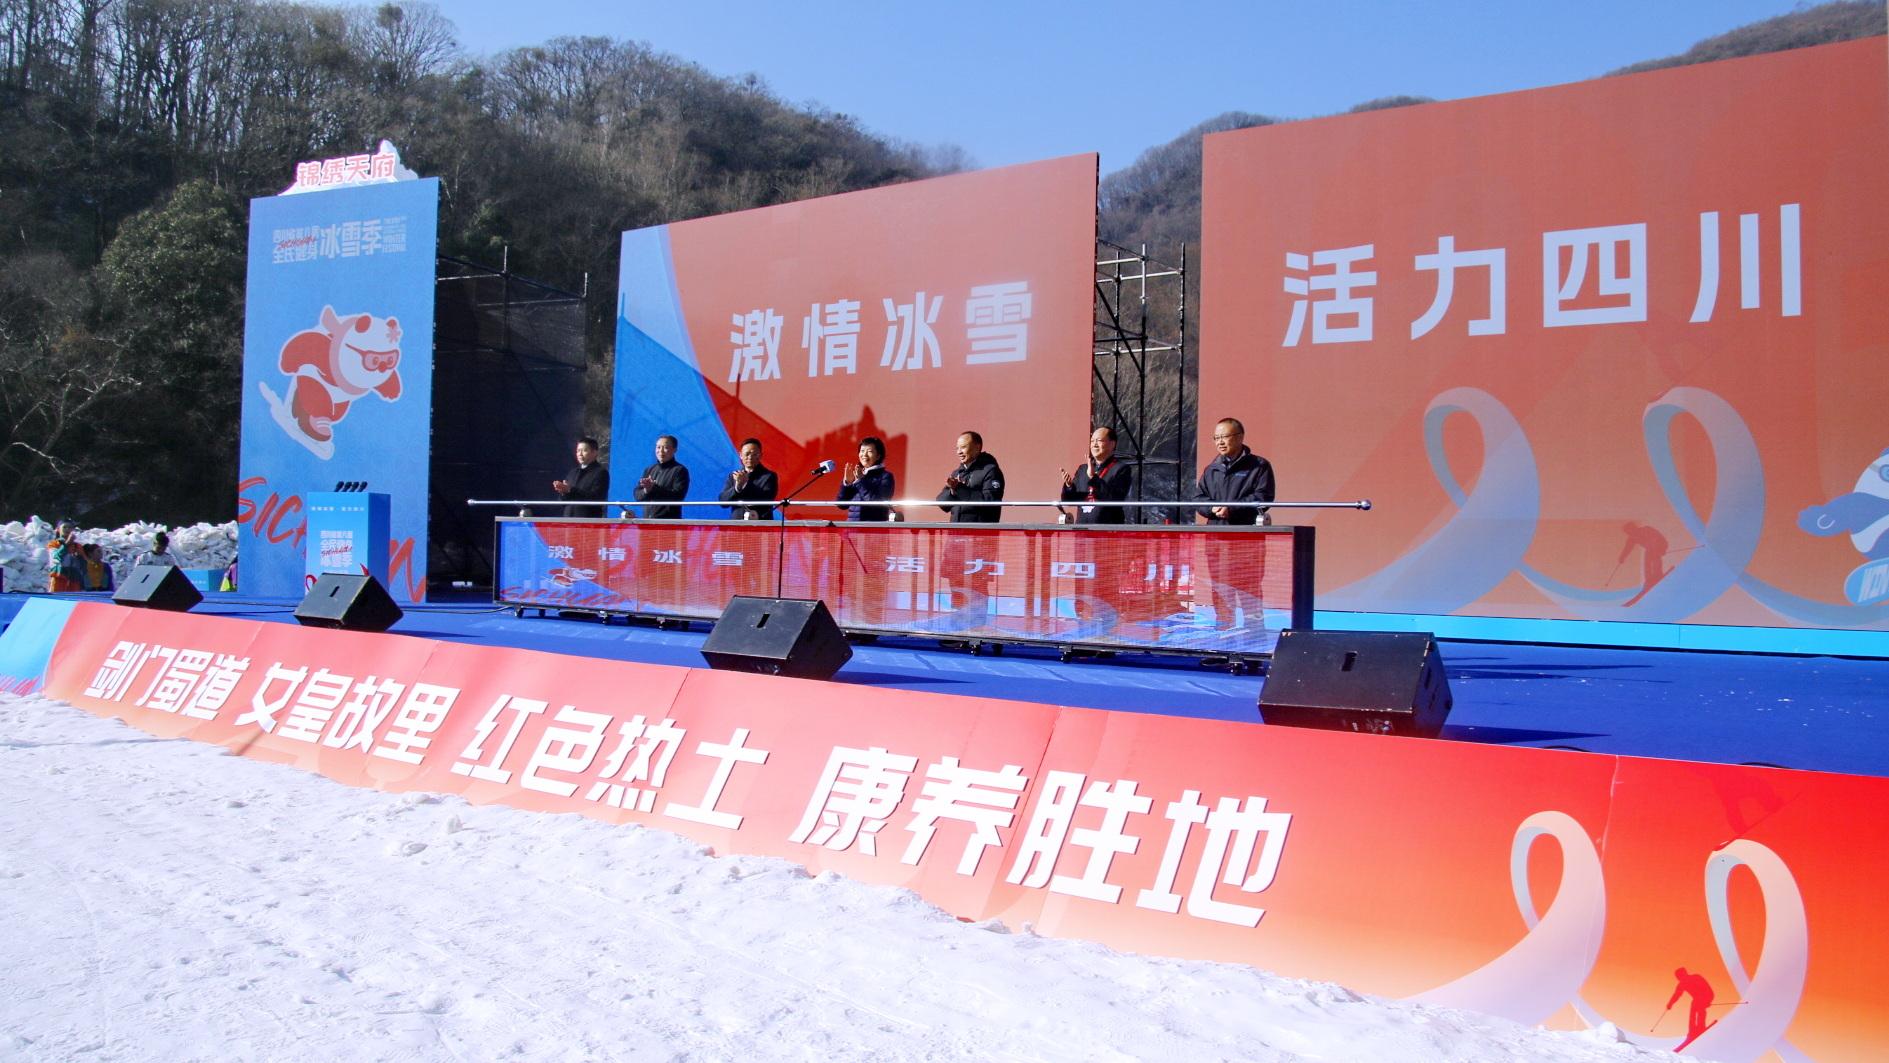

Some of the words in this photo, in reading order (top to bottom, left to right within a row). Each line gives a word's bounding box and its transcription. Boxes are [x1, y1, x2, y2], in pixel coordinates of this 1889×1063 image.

[298, 154, 395, 187] 锦绣天府
[319, 219, 383, 260] 冰雪季
[1282, 203, 1801, 347] 活力四川
[728, 281, 1033, 383] 激情冰雪
[548, 545, 744, 567] 激情冰雪
[885, 556, 1190, 583] 活力四川
[84, 640, 251, 721] 剑门蜀道
[234, 661, 460, 766] 女皇故里
[450, 693, 770, 831] 红色热土
[788, 745, 1293, 928] 康养胜地
